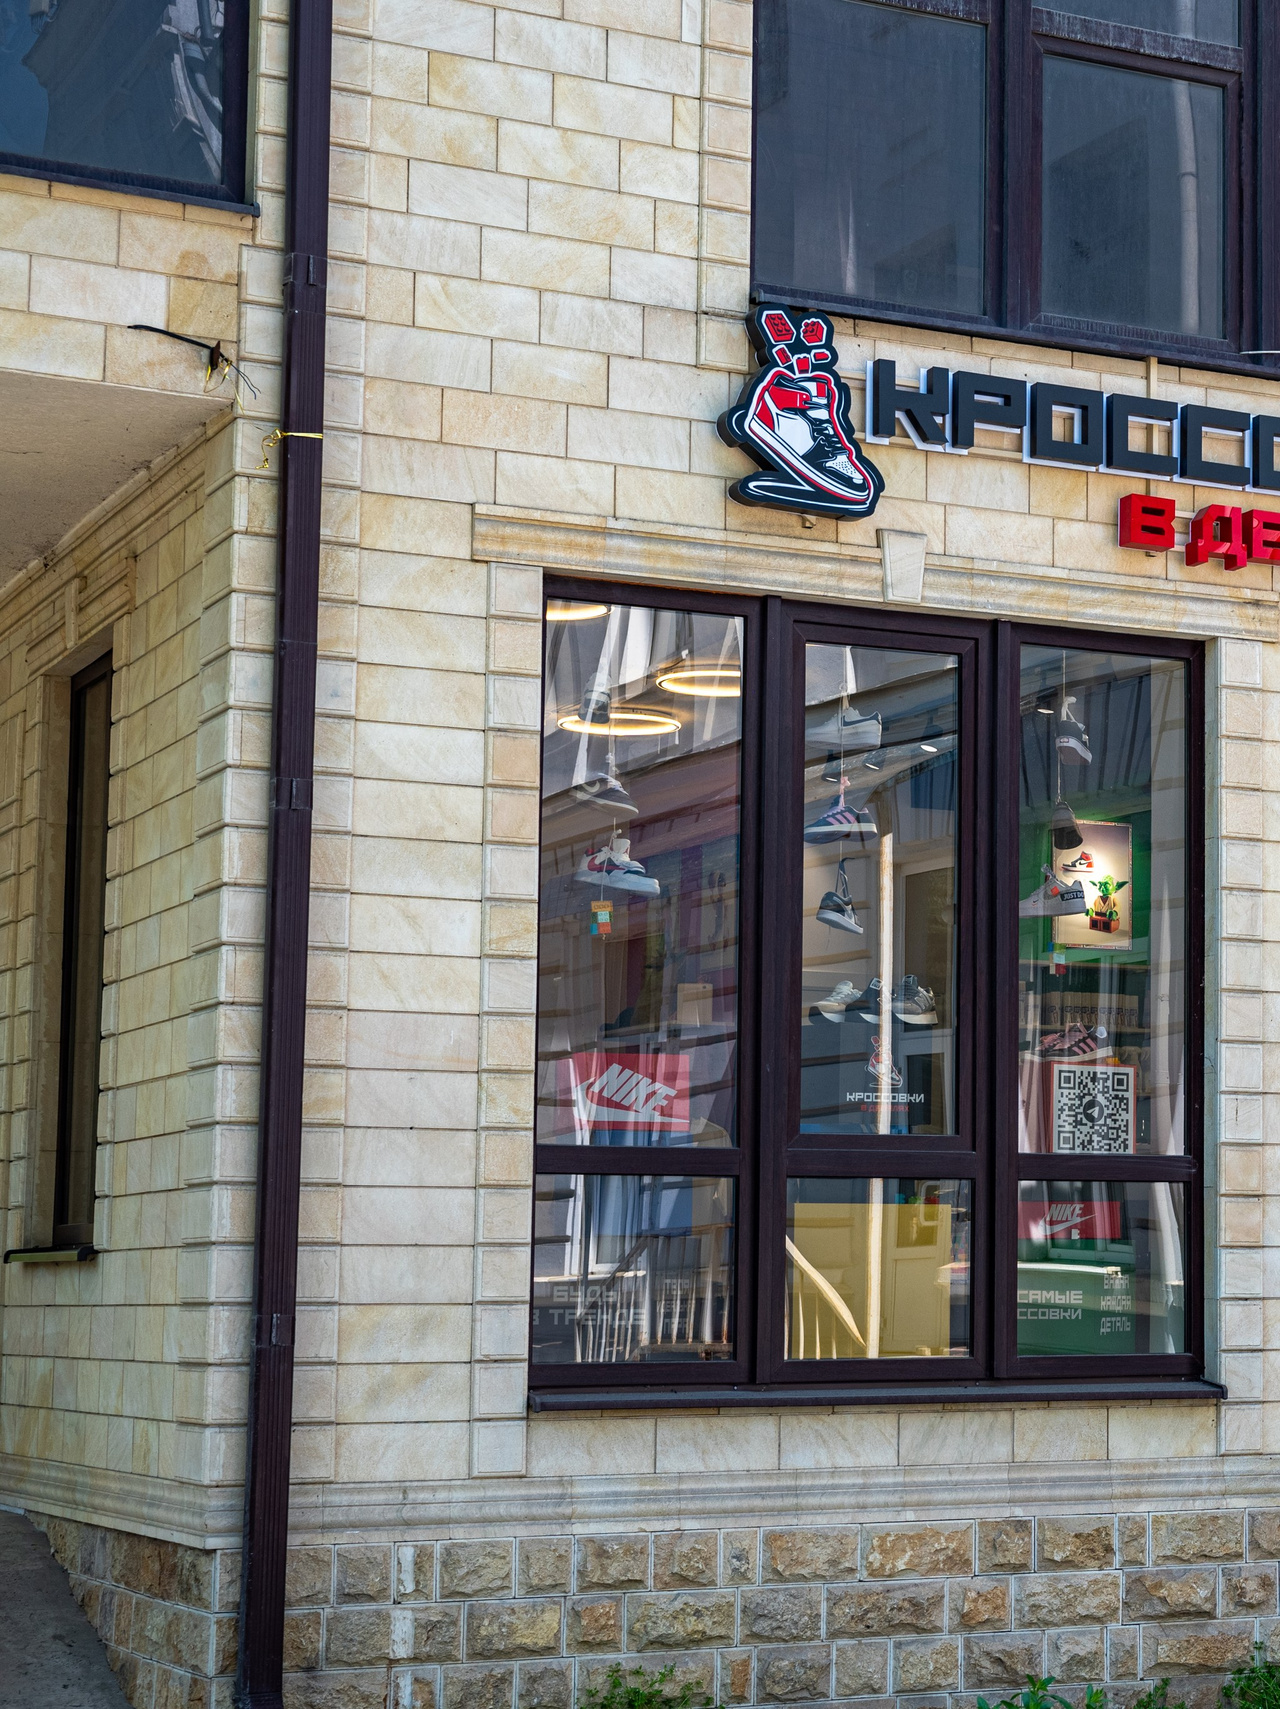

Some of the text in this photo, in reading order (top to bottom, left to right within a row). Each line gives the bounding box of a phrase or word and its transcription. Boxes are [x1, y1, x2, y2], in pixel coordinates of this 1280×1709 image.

[1118, 493, 1176, 552] В
[590, 1063, 678, 1116] NIKE
[1046, 1204, 1084, 1221] NIKE
[1017, 1291, 1083, 1304] САМЫЕ
[1100, 1295, 1131, 1313] КАЖДАЯ
[1100, 1317, 1131, 1335] ДЕТАЛЬ
